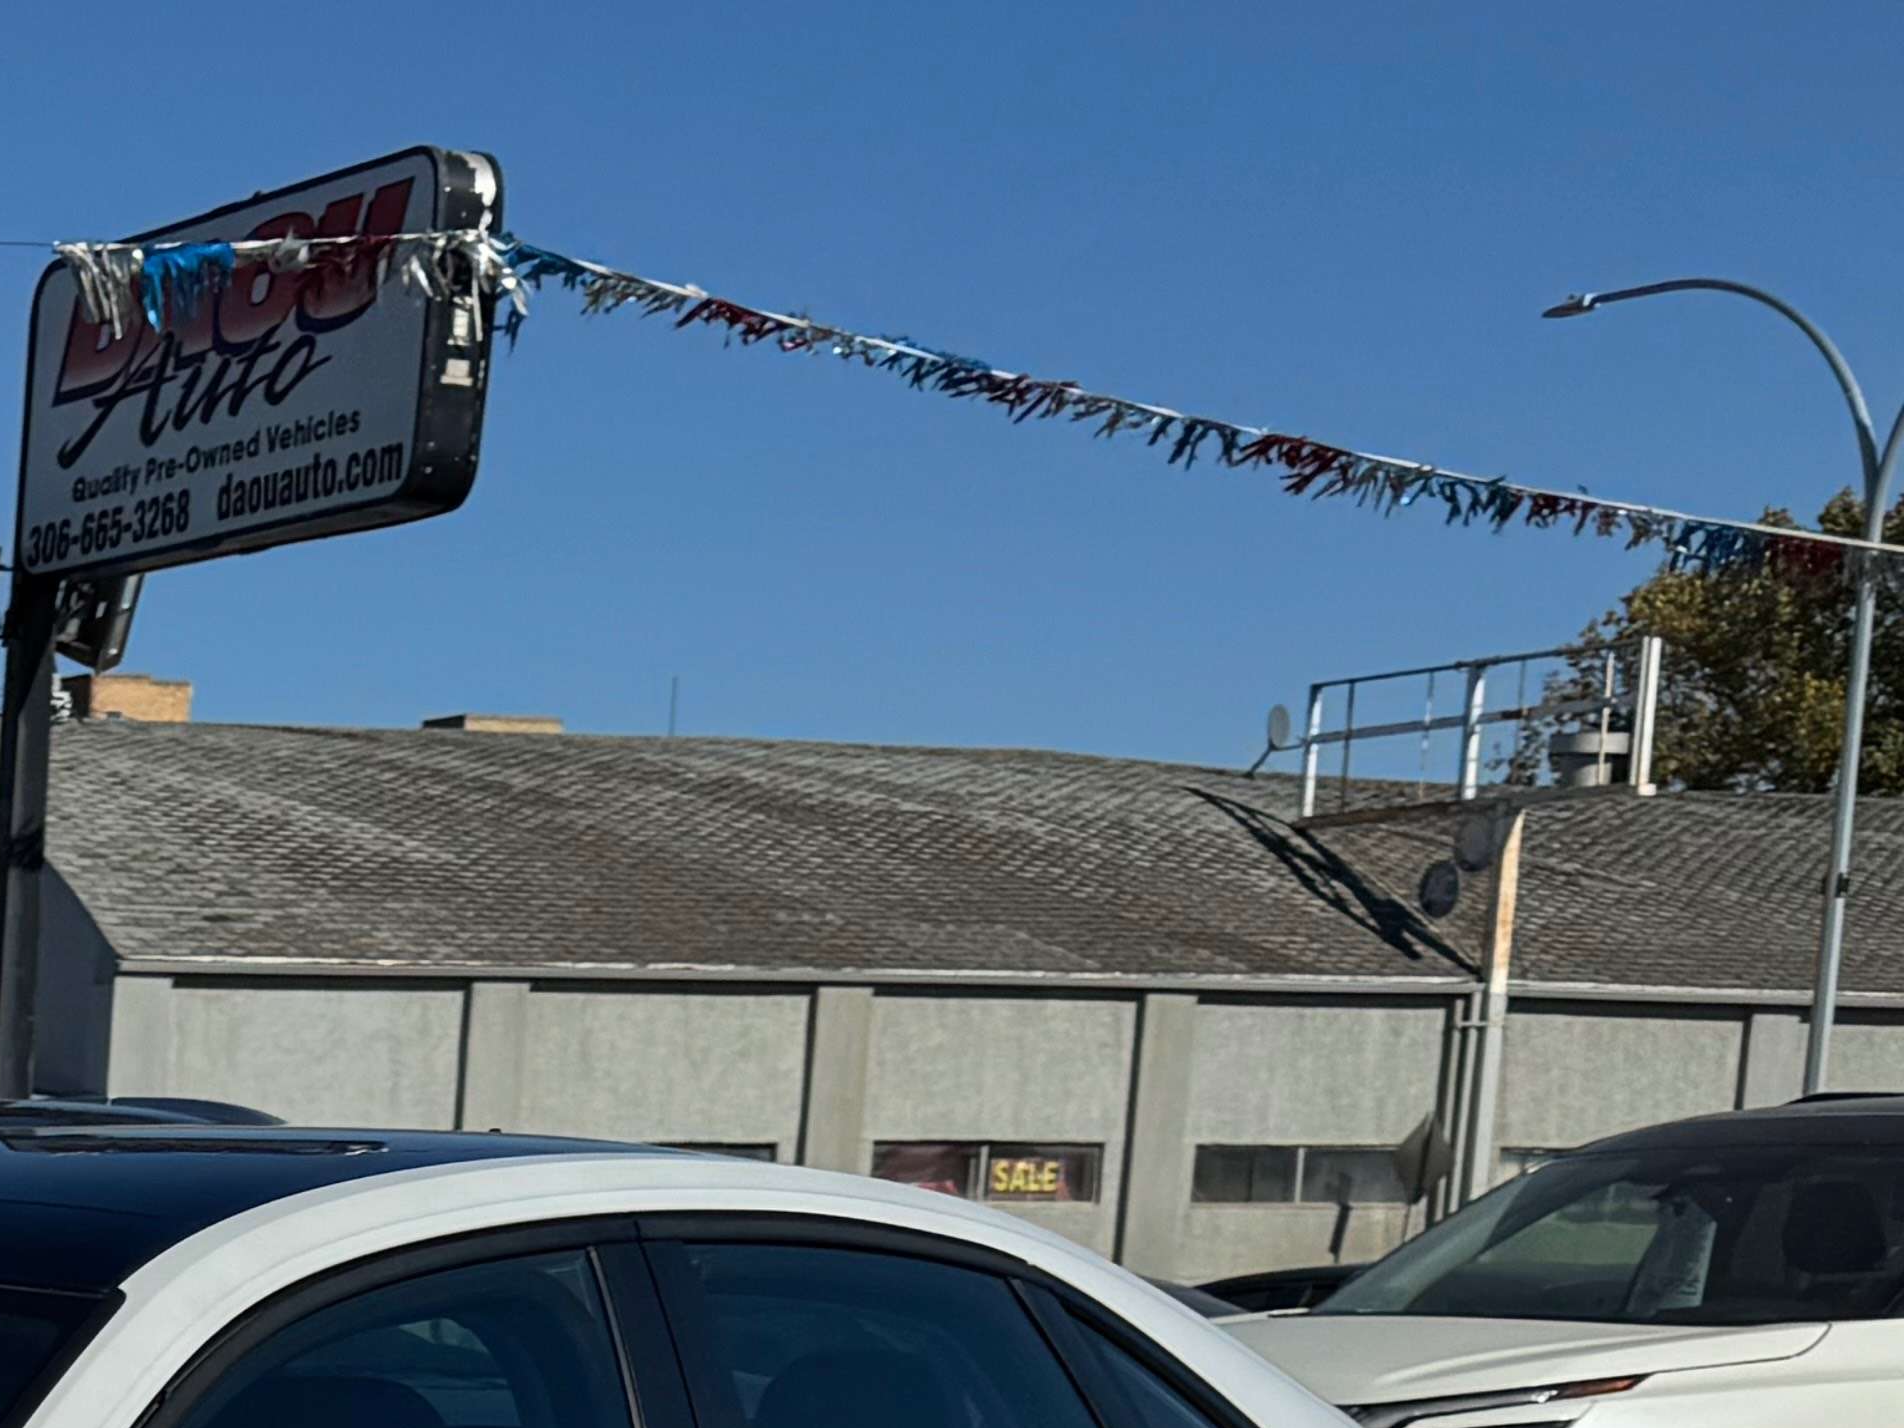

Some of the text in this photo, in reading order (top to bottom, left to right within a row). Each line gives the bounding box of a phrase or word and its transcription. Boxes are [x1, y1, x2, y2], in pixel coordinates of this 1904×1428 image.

[58, 332, 332, 468] Auto
[28, 441, 405, 567] 306-665-3268 daouauto.com
[72, 408, 362, 504] Quality Pre-Owned Vehicles
[994, 1161, 1058, 1192] SALE
